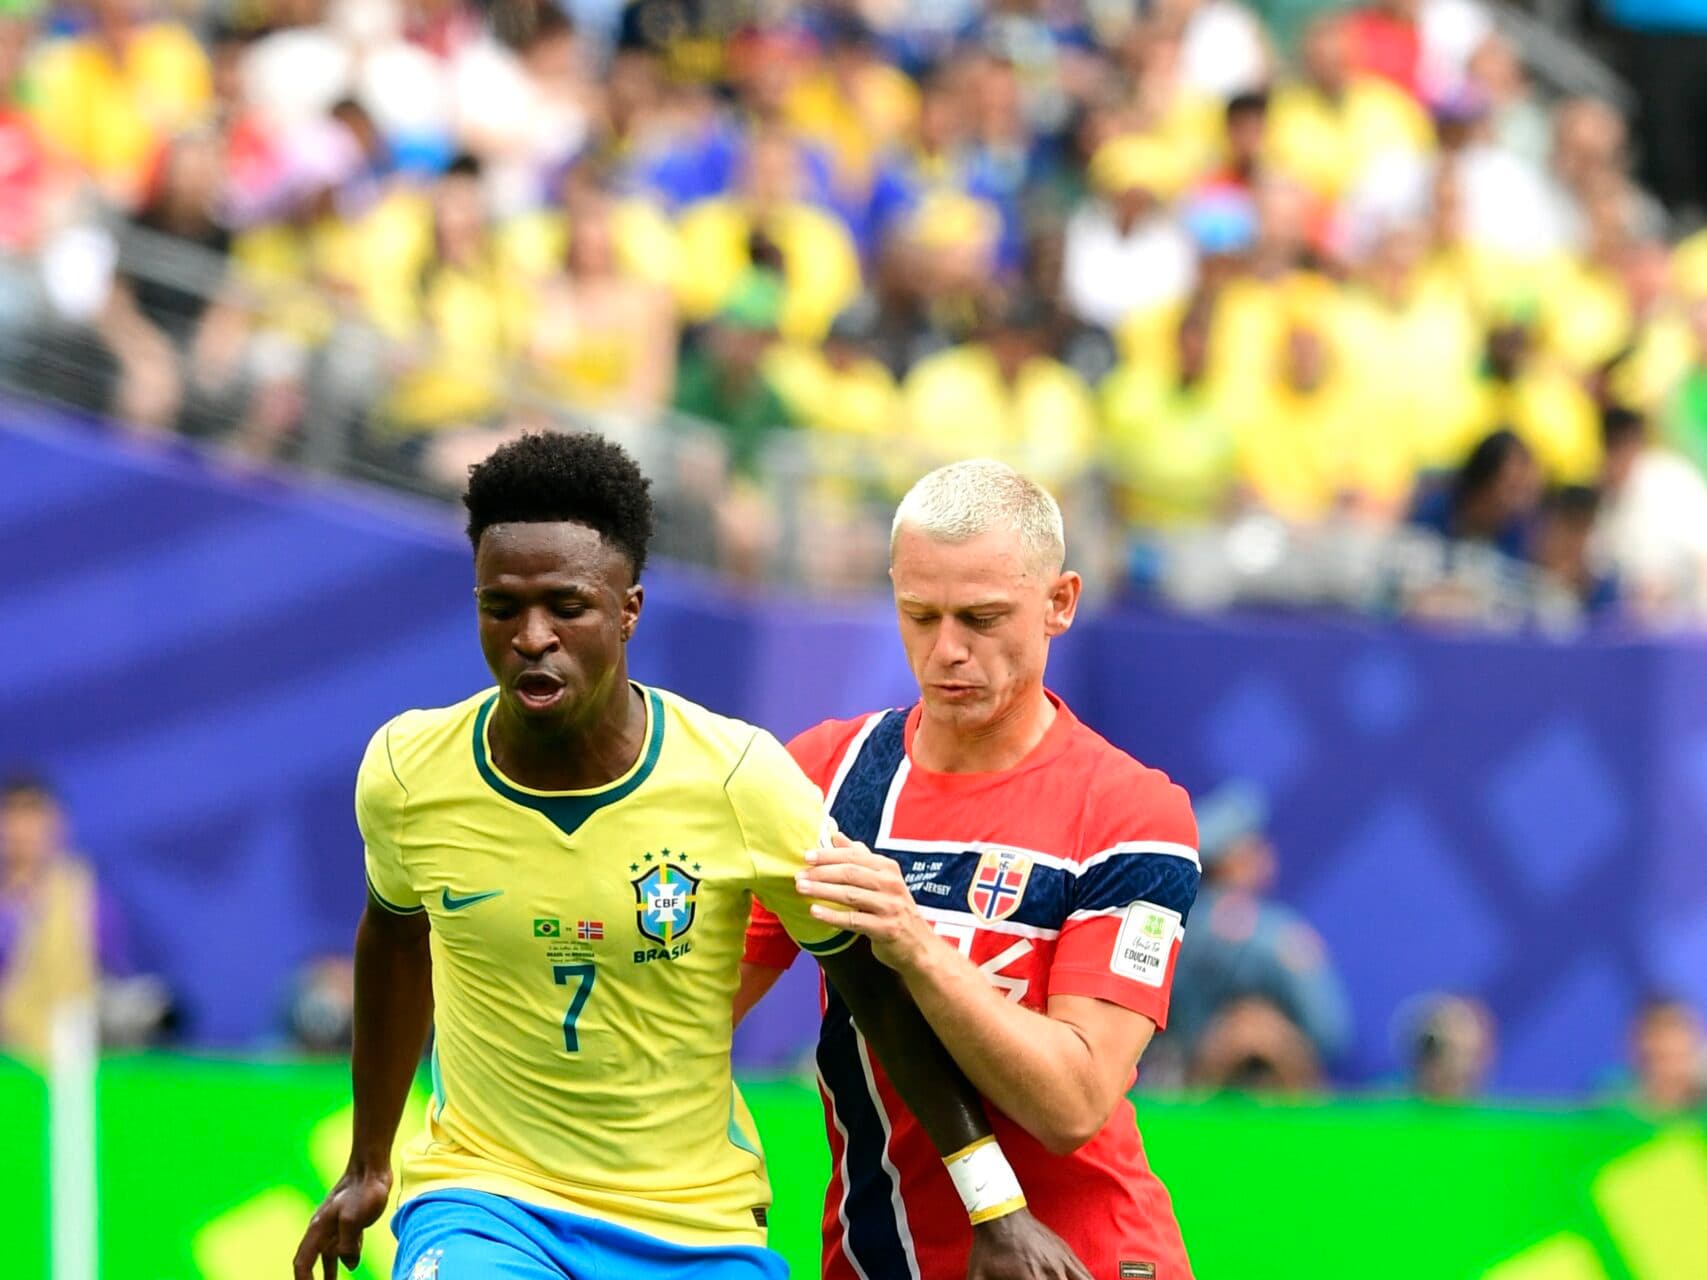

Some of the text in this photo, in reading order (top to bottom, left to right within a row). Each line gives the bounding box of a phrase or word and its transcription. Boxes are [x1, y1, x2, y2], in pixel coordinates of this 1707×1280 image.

[923, 881, 951, 896] JERSEY
[654, 898, 679, 909] CBF
[633, 942, 691, 963] BRASIL
[1124, 948, 1160, 968] EDUCATION
[553, 965, 595, 1052] 7
